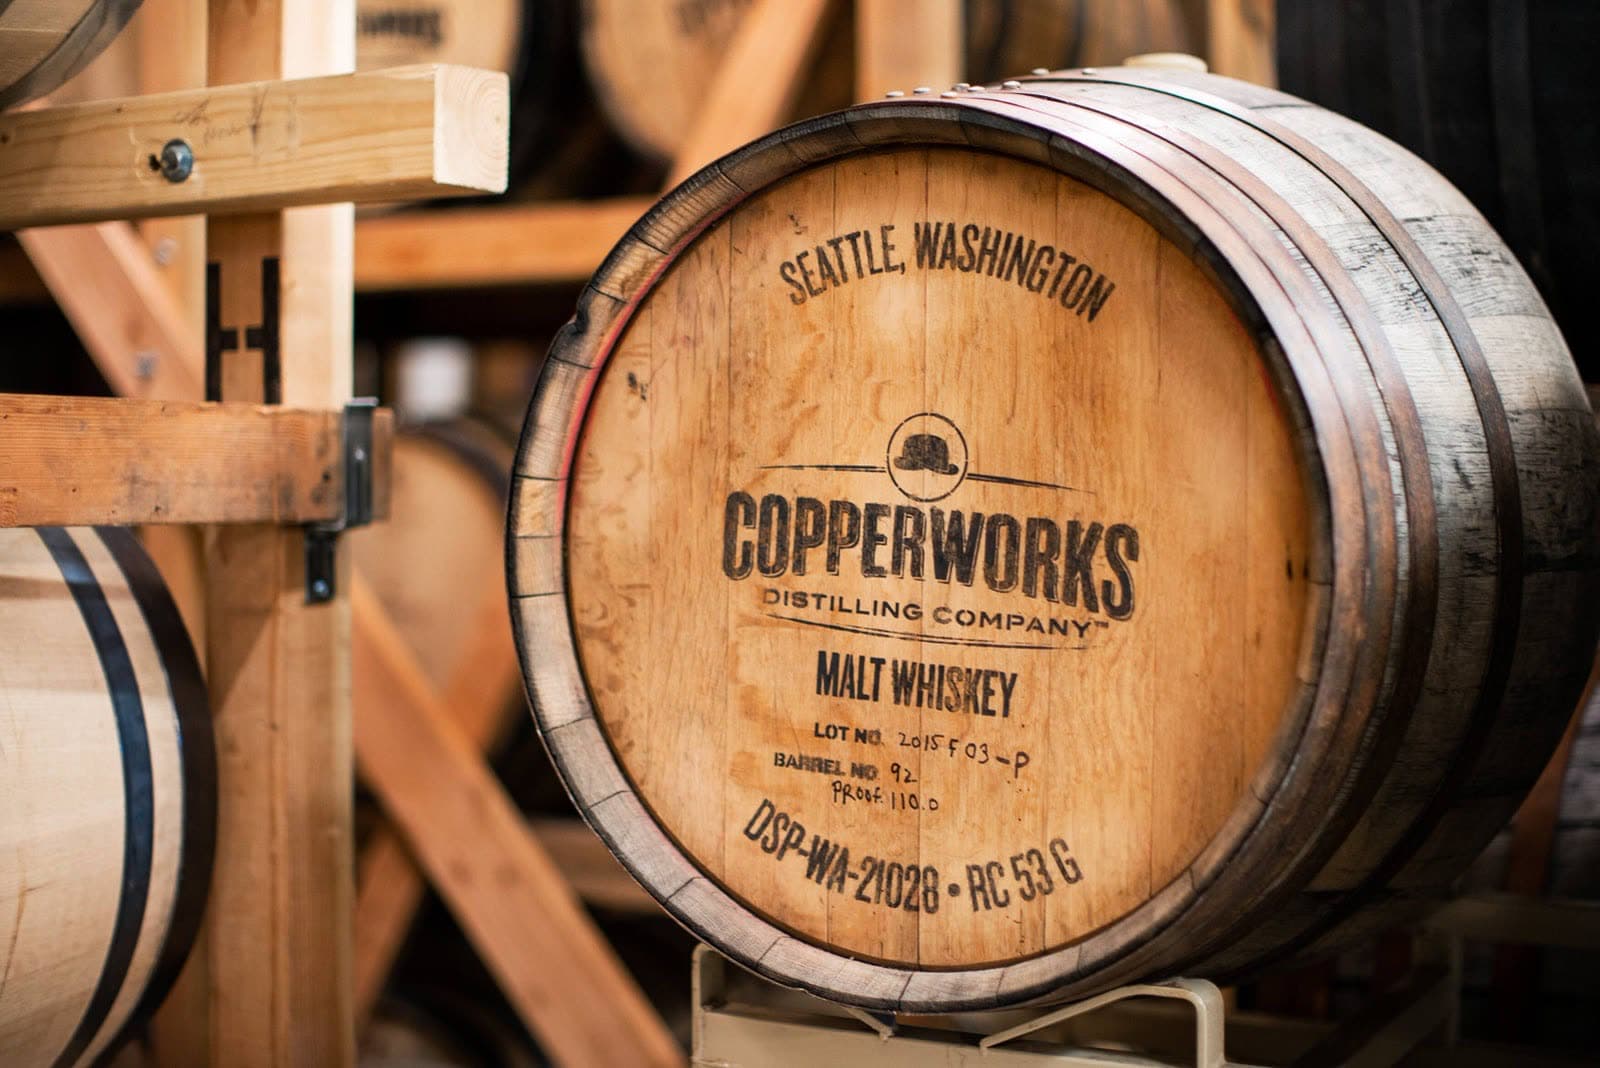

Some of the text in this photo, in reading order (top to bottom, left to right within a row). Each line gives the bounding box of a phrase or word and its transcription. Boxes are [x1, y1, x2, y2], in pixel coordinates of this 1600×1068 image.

[779, 221, 1116, 323] SEATTLE, WASHINGTON
[722, 491, 1140, 622] COPPERWORKS
[763, 588, 923, 621] DISTILLING
[816, 651, 1019, 718] MALT WHISKEY
[814, 722, 850, 741] LOT
[774, 752, 846, 777] BARREL
[890, 763, 917, 783] 92
[891, 791, 939, 811] 110.0
[743, 799, 940, 914] DSP-WA-21028
[966, 861, 1010, 912] RC
